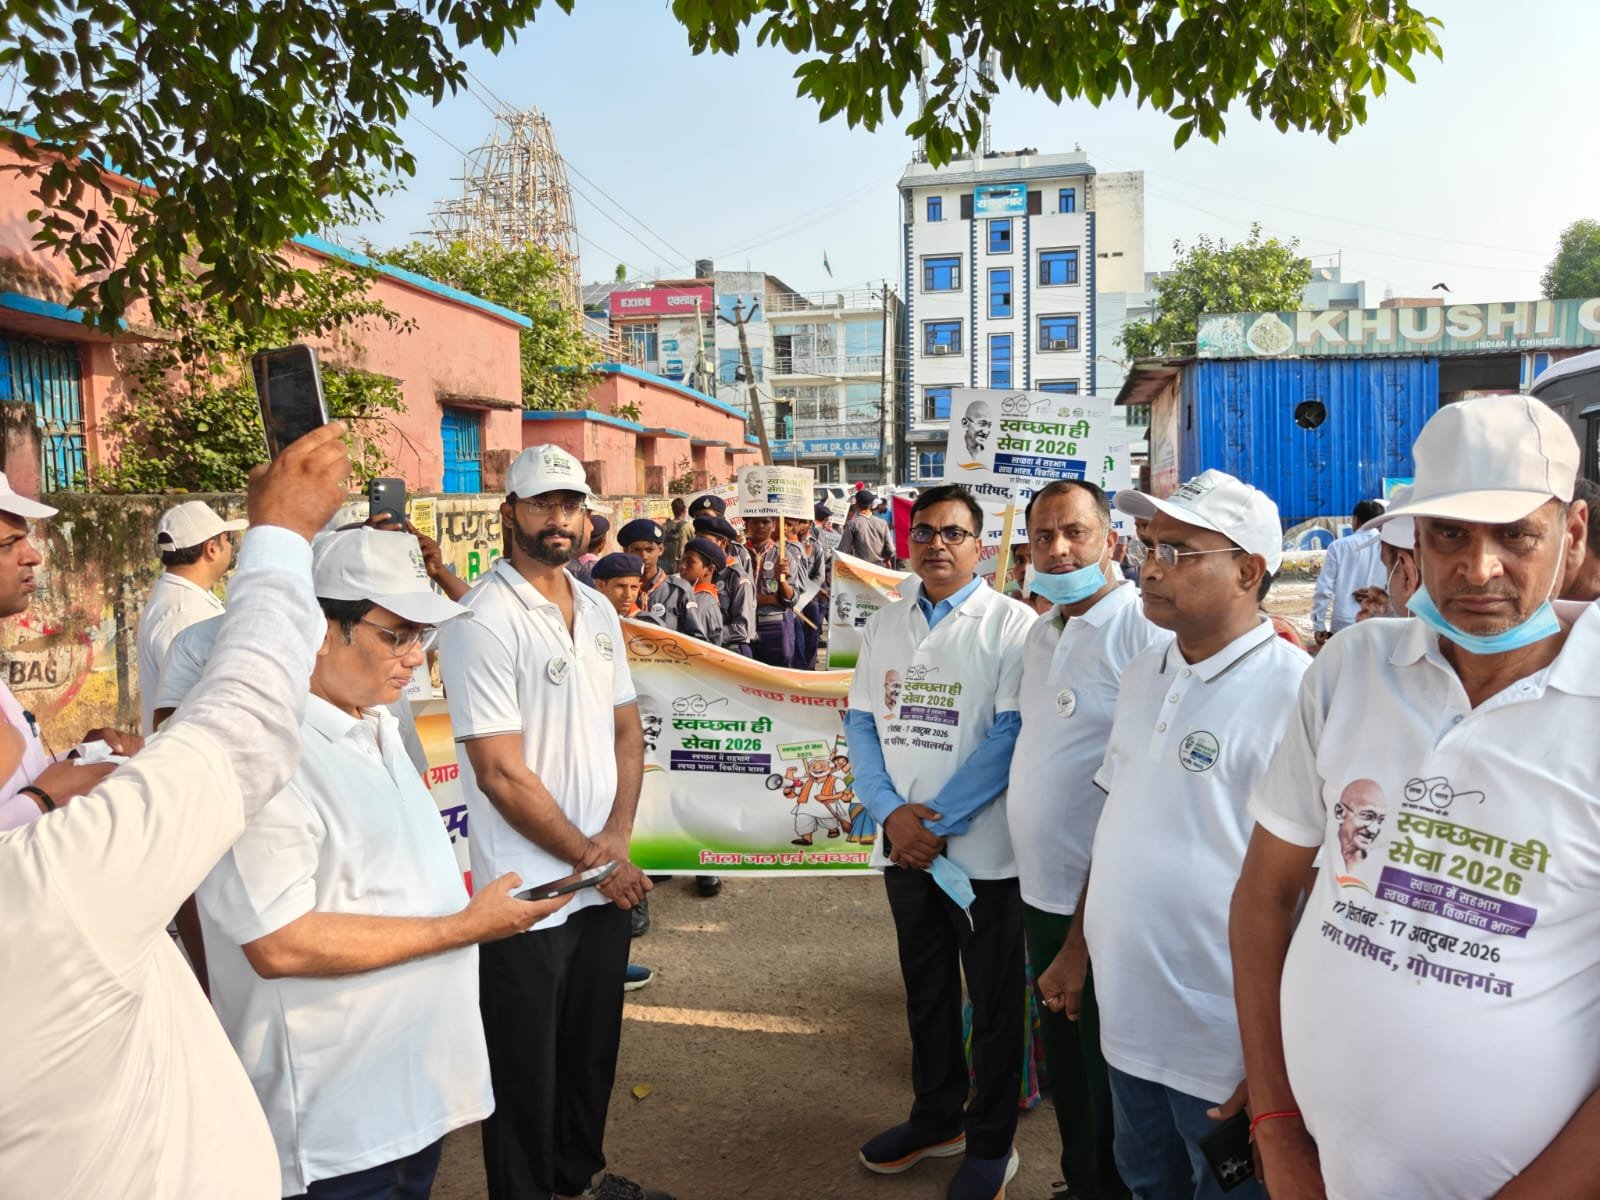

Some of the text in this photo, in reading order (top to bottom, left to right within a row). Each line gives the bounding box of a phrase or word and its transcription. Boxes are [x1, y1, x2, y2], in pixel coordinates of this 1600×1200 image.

[621, 297, 651, 308] EXIDE
[1297, 301, 1554, 345] KHUSHI
[1477, 337, 1561, 349] INDIAN & CHINESE
[1000, 419, 1090, 438] स्वच्छता ही
[997, 433, 1077, 456] सेवा 2026
[974, 484, 1014, 500] परिषद,
[9, 660, 57, 685] BAG
[790, 694, 839, 708] भारत
[902, 692, 954, 708] सेवा 2026
[671, 716, 774, 733] स्वच्छता ही
[681, 734, 762, 751] सेवा 2026
[1397, 811, 1552, 874] स्वच्छता ही
[700, 850, 870, 864] जिला जल एवं स्वच्छता
[1388, 837, 1523, 896] सेवा 2026
[1410, 877, 1502, 914] स्वच्छता में सहभाग
[1383, 888, 1410, 906] स्वच्छ
[1412, 894, 1440, 916] भारत,
[1442, 902, 1488, 929] विकसित
[1390, 919, 1407, 936] 17
[1459, 941, 1501, 963] 2026
[1343, 932, 1399, 972] परिषद,
[1406, 953, 1515, 998] गोपालगंज
